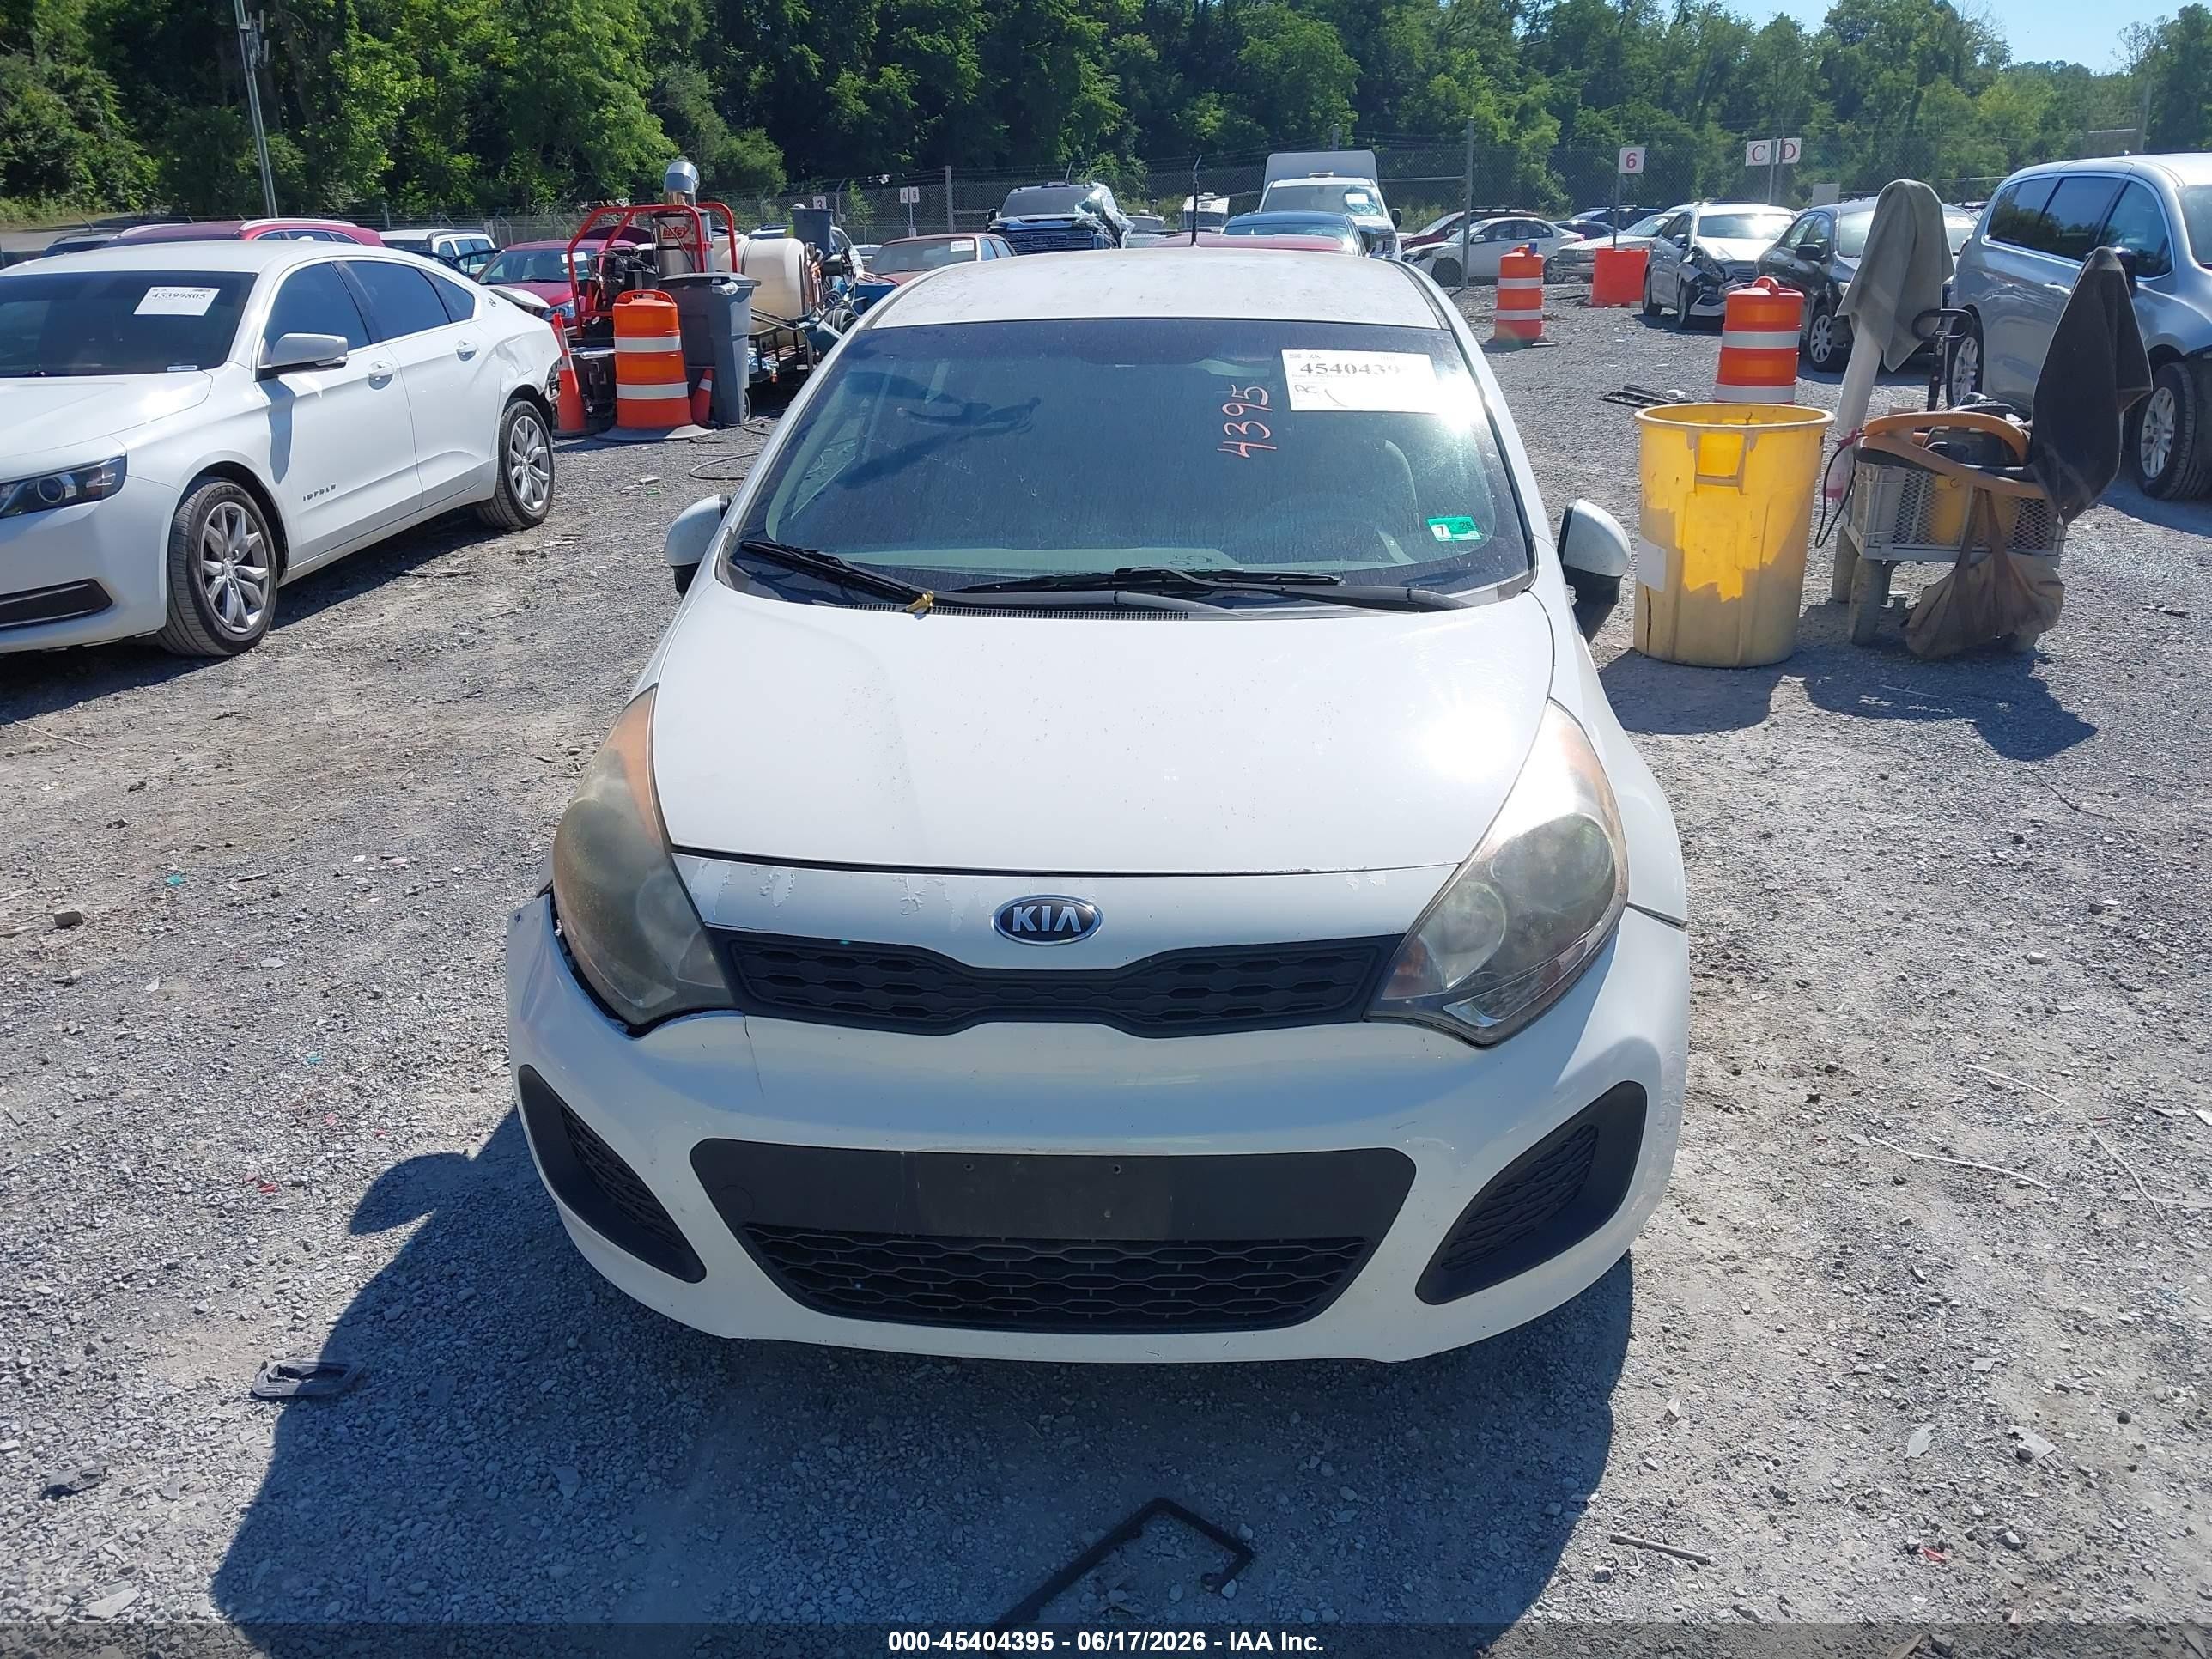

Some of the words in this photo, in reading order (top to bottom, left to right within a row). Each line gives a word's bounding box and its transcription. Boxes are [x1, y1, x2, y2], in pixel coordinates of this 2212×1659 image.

[1753, 144, 1765, 161] C
[1781, 143, 1796, 160] D
[1626, 152, 1638, 169] 6
[1299, 362, 1410, 376] 4540439
[1216, 384, 1278, 458] 4395
[1012, 905, 1082, 933] KIA
